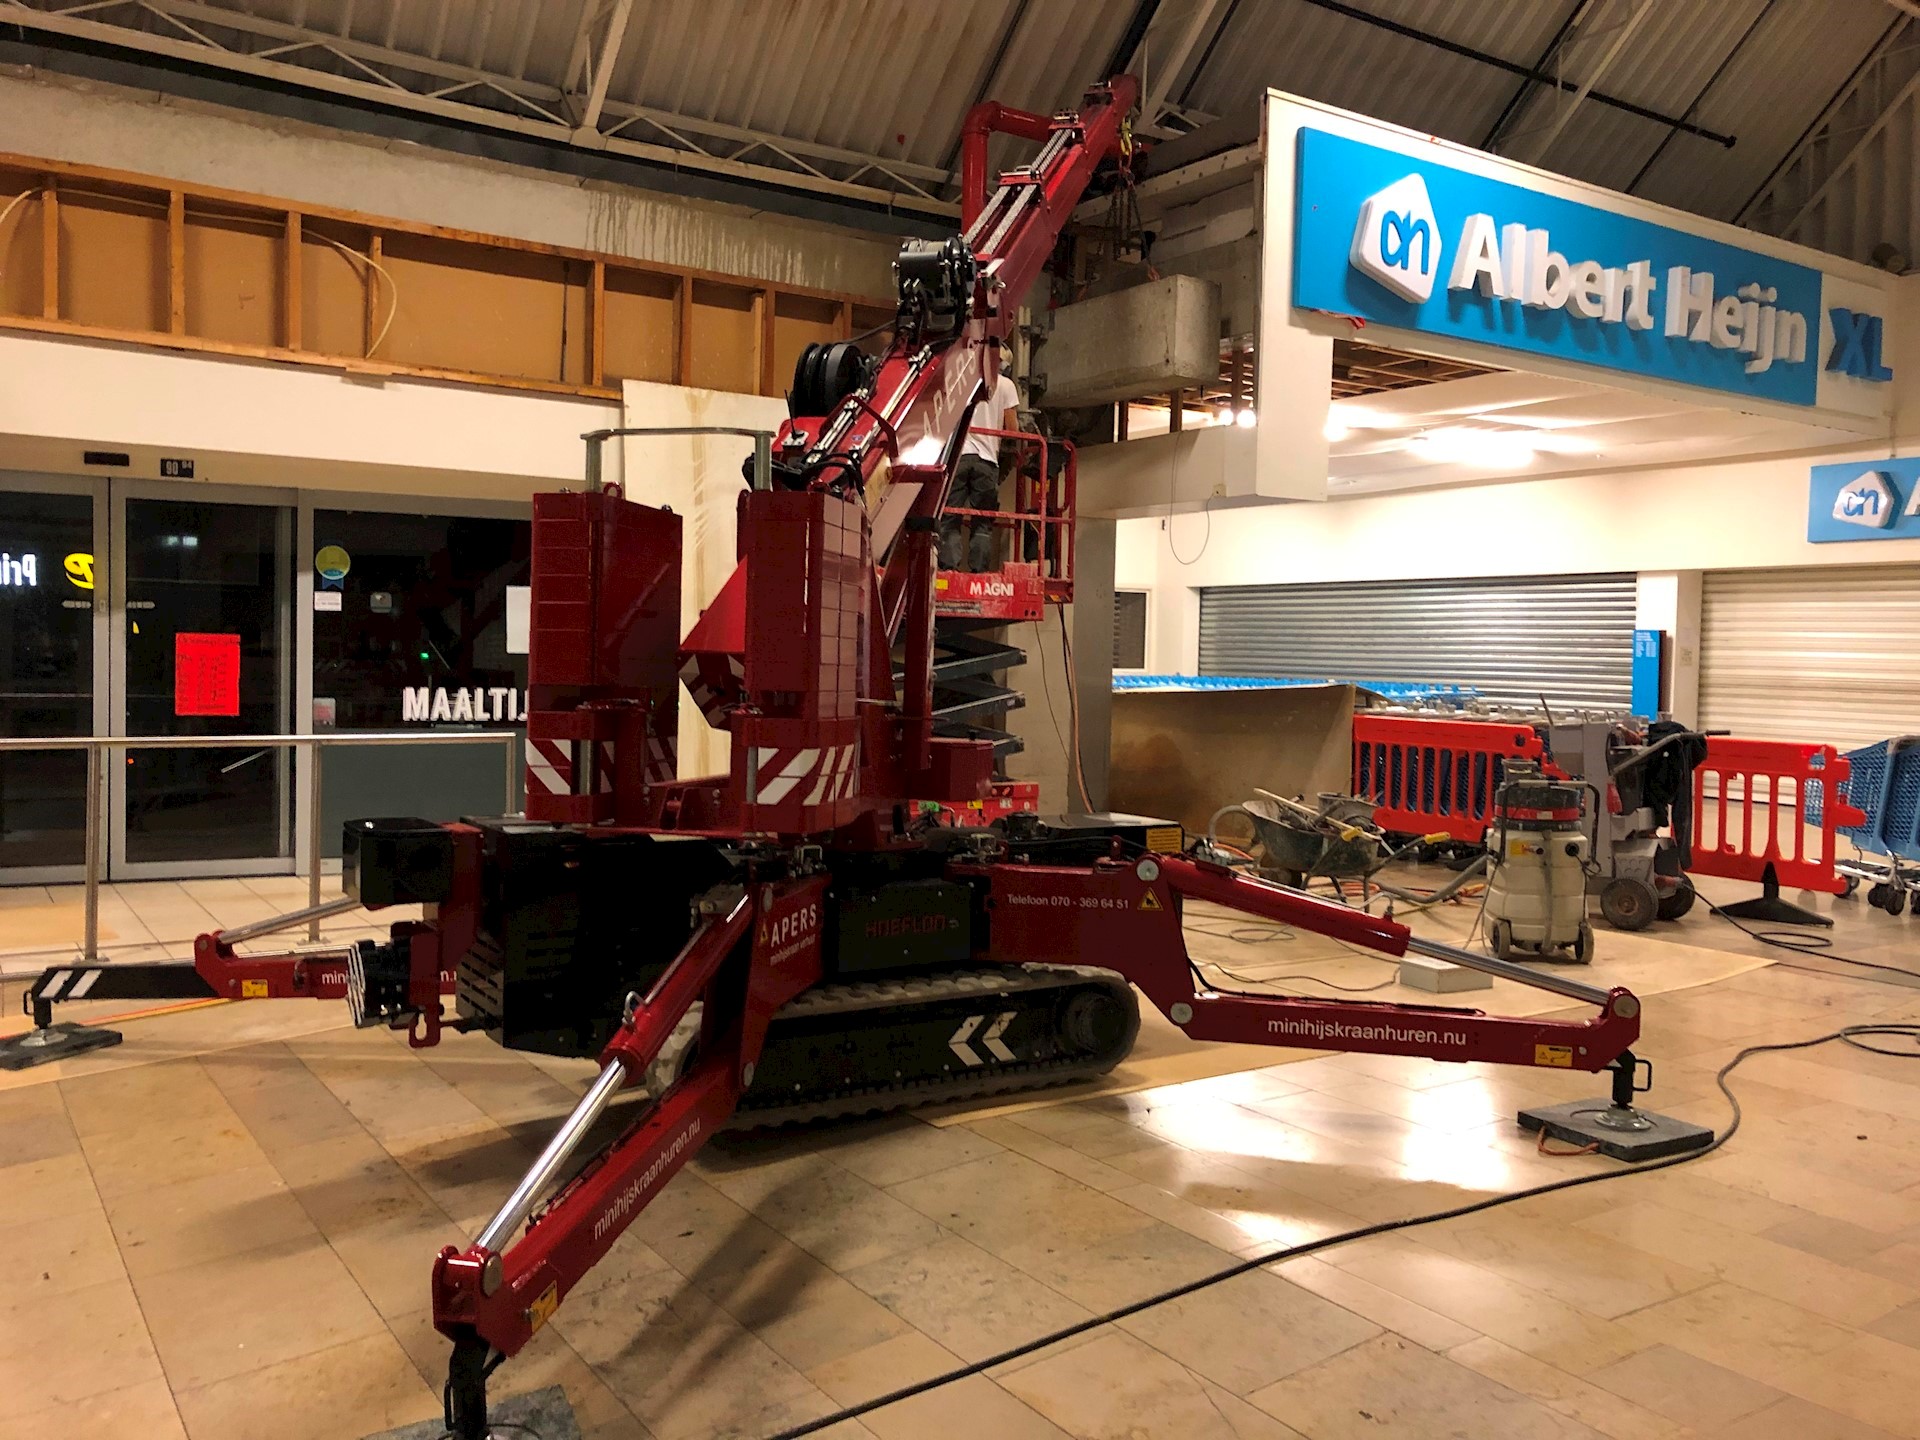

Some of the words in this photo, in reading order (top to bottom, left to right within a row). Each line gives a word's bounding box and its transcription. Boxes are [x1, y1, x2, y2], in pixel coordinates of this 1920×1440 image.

[1448, 212, 1656, 331] Albert
[1665, 265, 1806, 373] Heijn
[1826, 307, 1893, 382] XL
[970, 580, 1015, 597] MAGNI
[1007, 893, 1047, 905] Telefoon
[1050, 895, 1071, 907] 070
[1079, 896, 1099, 909] 369
[1100, 897, 1114, 909] 64
[1116, 898, 1129, 909] 51
[771, 902, 817, 948] APERS
[1267, 1018, 1468, 1046] minihijskraanhuren.nu
[593, 1117, 702, 1241] minihijskraanhuren.nu
